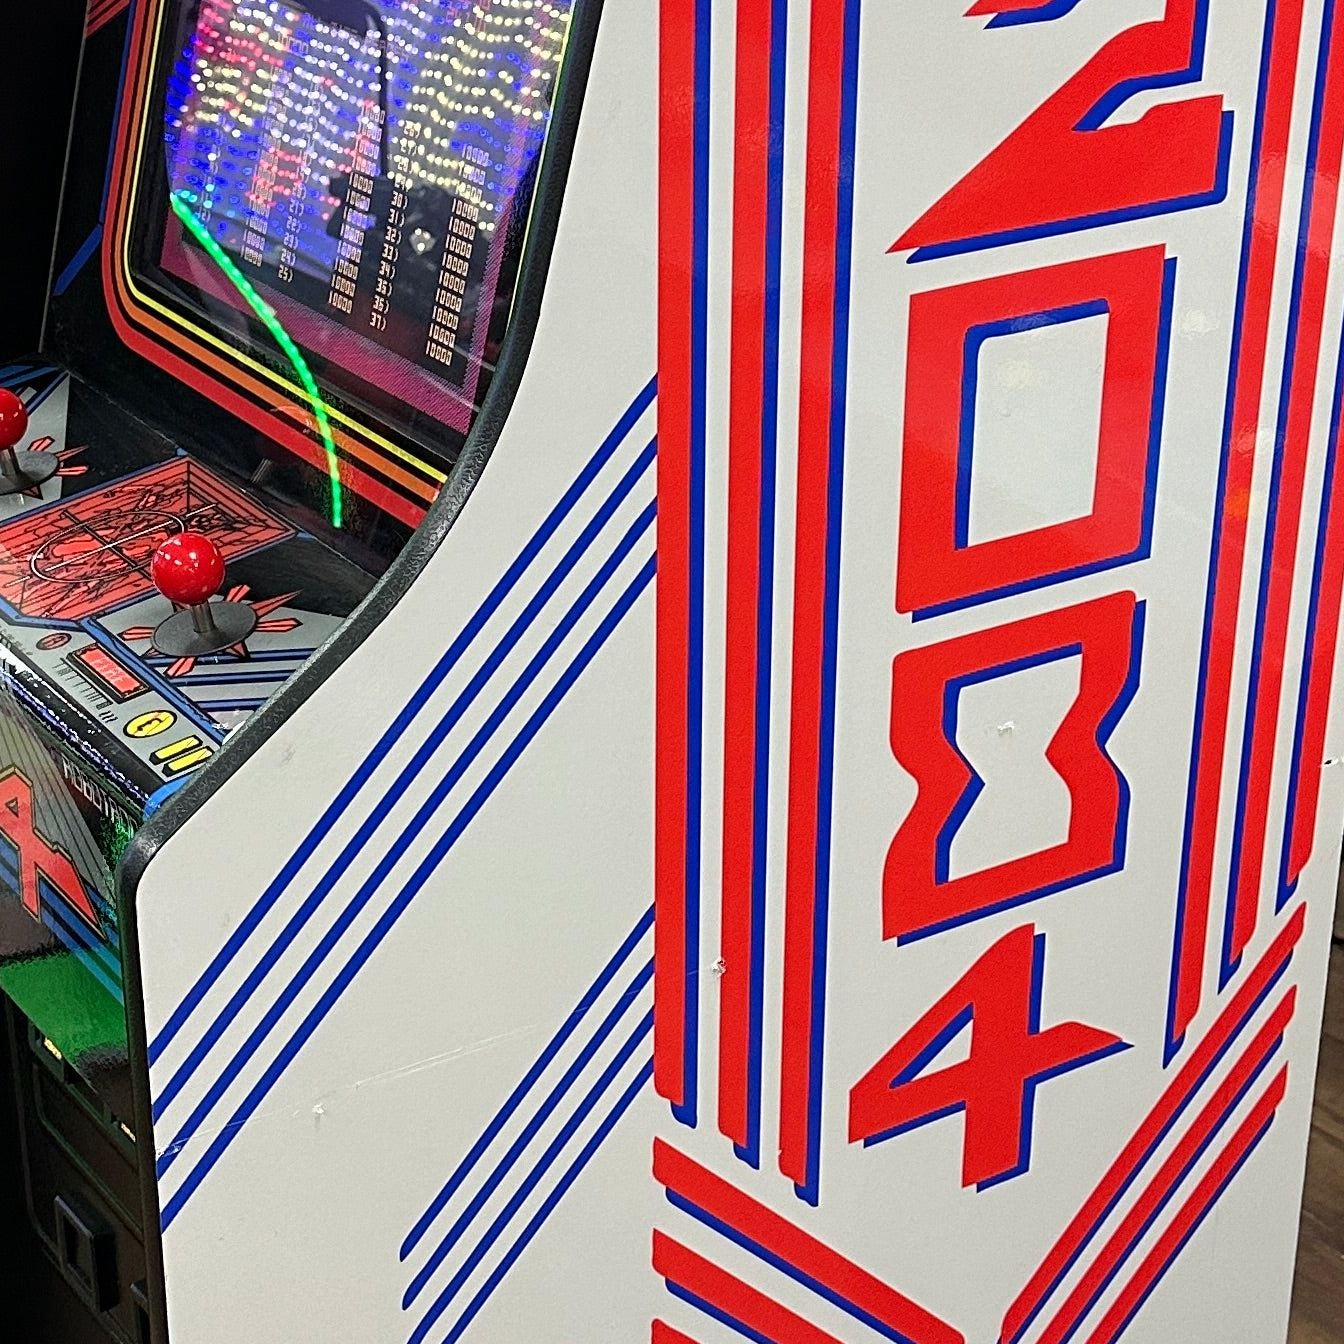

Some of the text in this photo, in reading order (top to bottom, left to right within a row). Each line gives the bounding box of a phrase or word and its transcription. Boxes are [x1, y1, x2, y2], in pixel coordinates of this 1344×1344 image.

[386, 206, 473, 259] 31) 10000
[389, 189, 477, 240] 30) 10000
[450, 196, 480, 222] 10000
[380, 241, 467, 295] 33) 10000
[383, 224, 470, 277] 32) 10000
[378, 259, 464, 313] 34) 10000
[369, 311, 454, 367] 37) 10000
[428, 321, 457, 349] 10000
[431, 304, 461, 331] 10000
